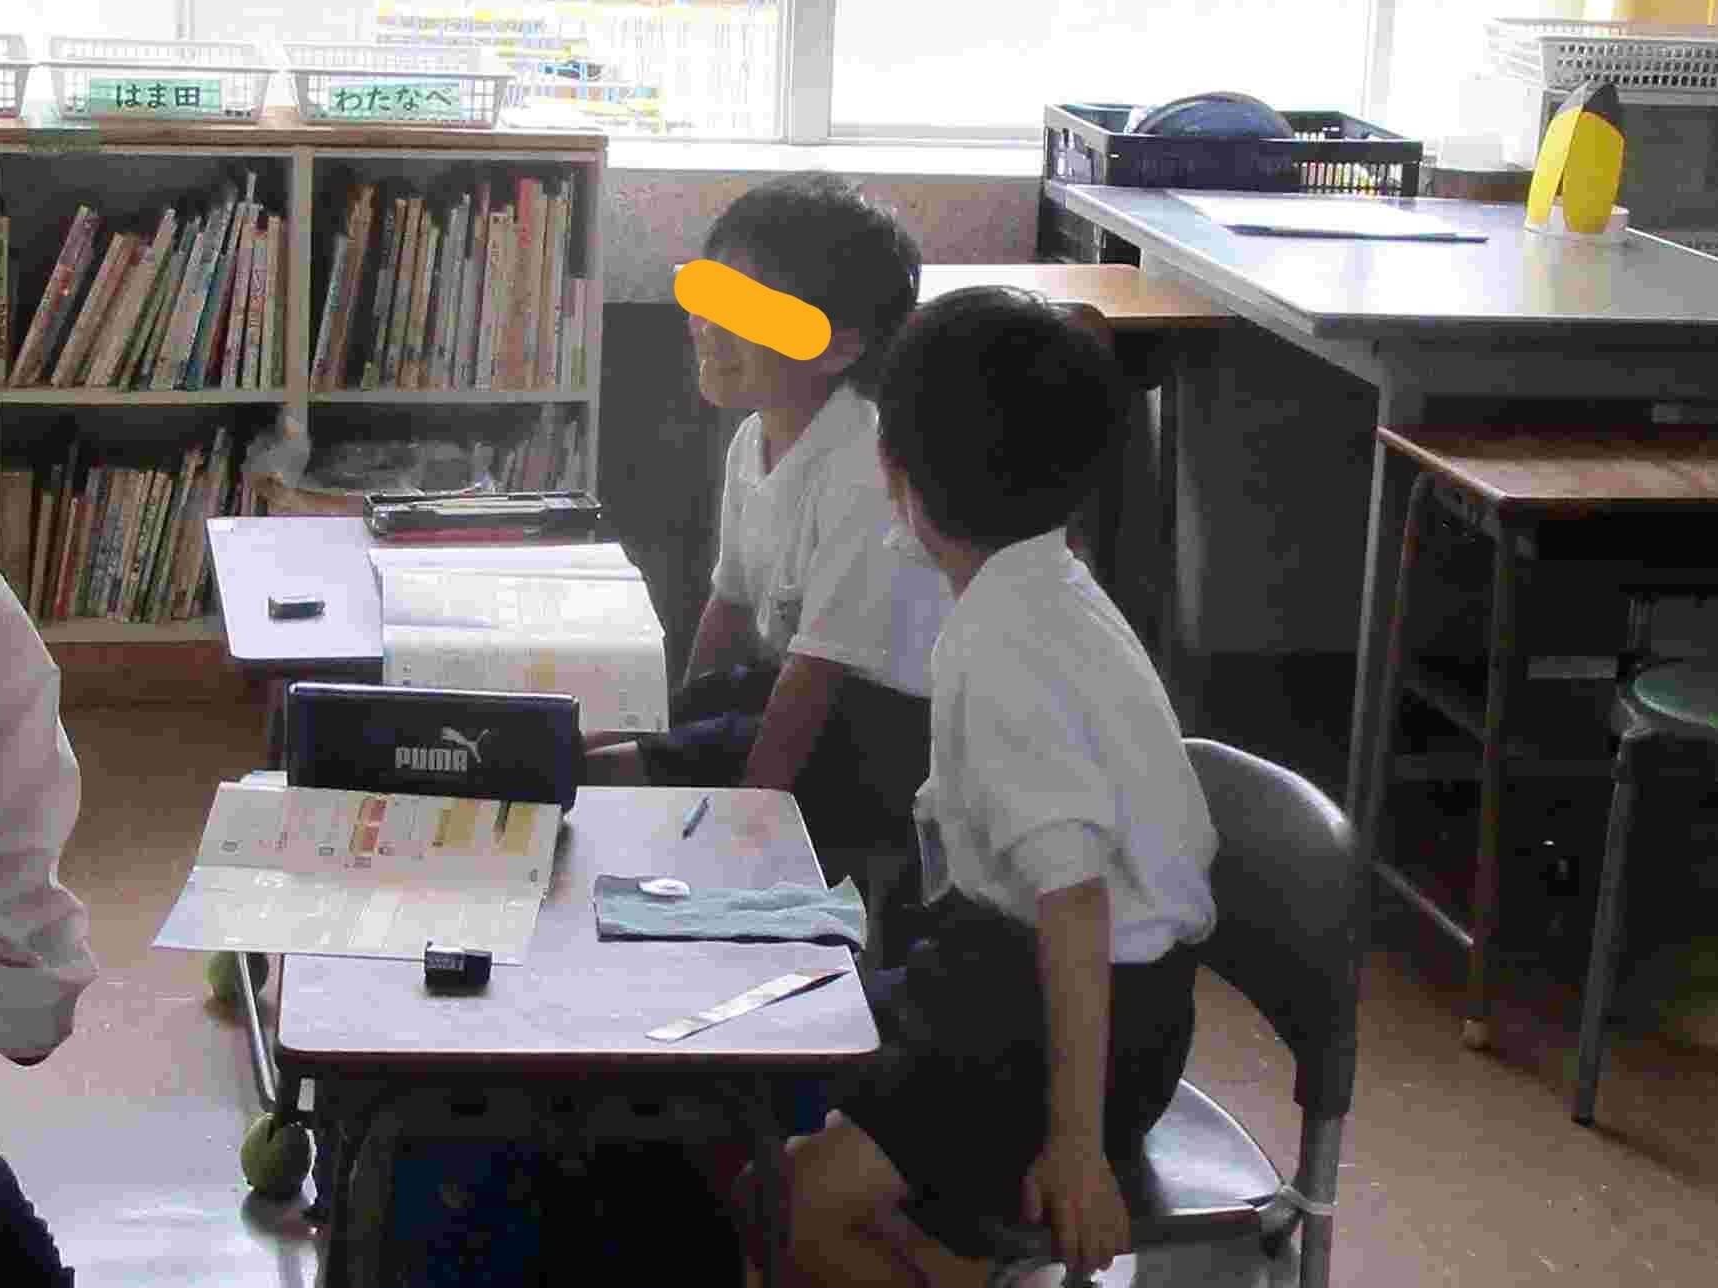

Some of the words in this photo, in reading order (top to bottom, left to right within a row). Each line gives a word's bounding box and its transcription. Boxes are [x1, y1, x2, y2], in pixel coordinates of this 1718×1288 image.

[116, 83, 201, 109] はま田
[394, 745, 468, 773] PUMA
